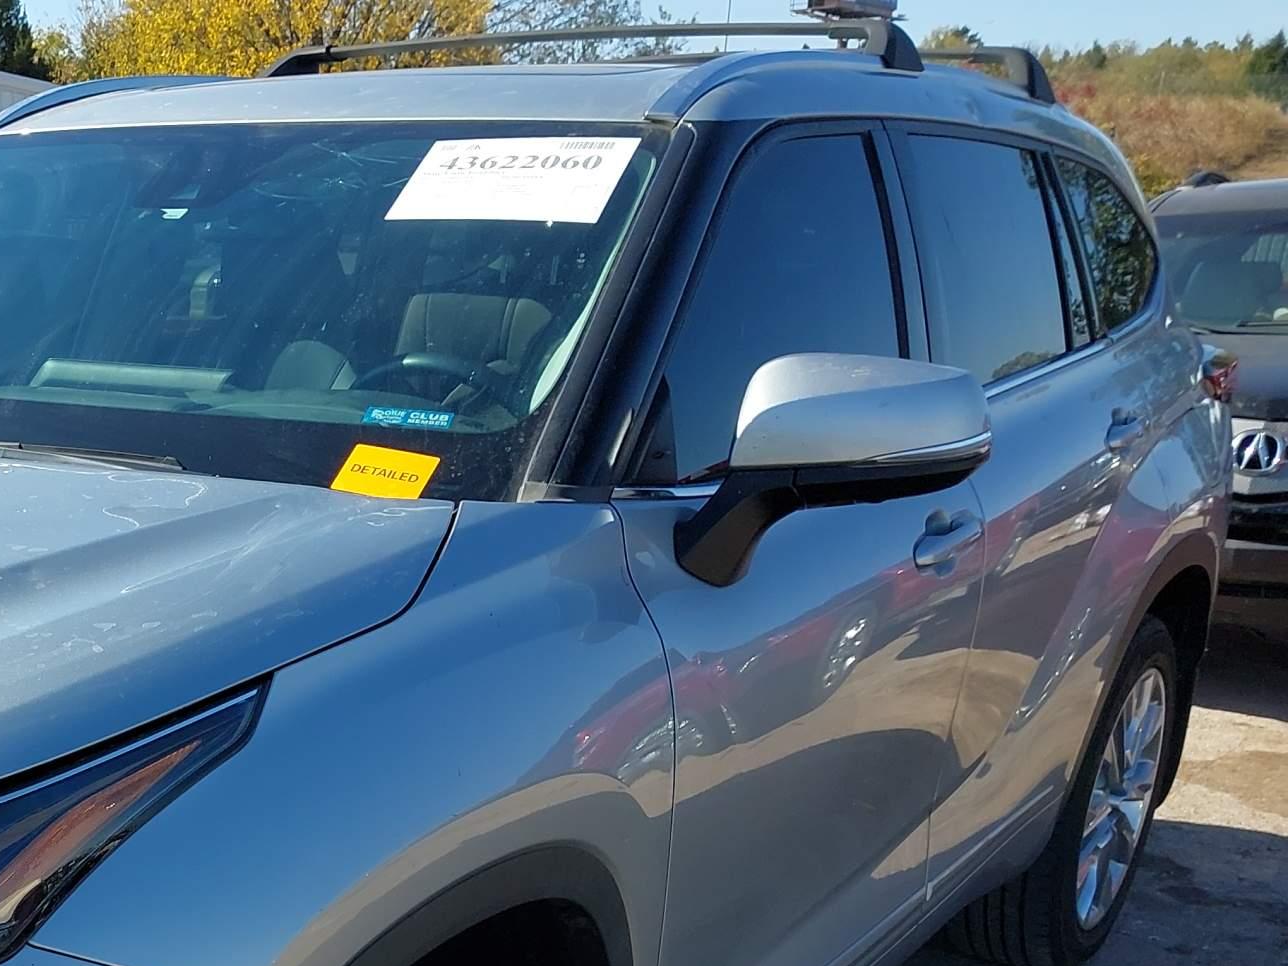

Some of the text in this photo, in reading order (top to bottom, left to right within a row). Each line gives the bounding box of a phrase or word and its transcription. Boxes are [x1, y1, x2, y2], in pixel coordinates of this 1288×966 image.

[440, 154, 603, 170] 43622060
[406, 418, 448, 426] MEMBER
[409, 412, 449, 421] CLUB
[350, 463, 419, 483] DETAILED
